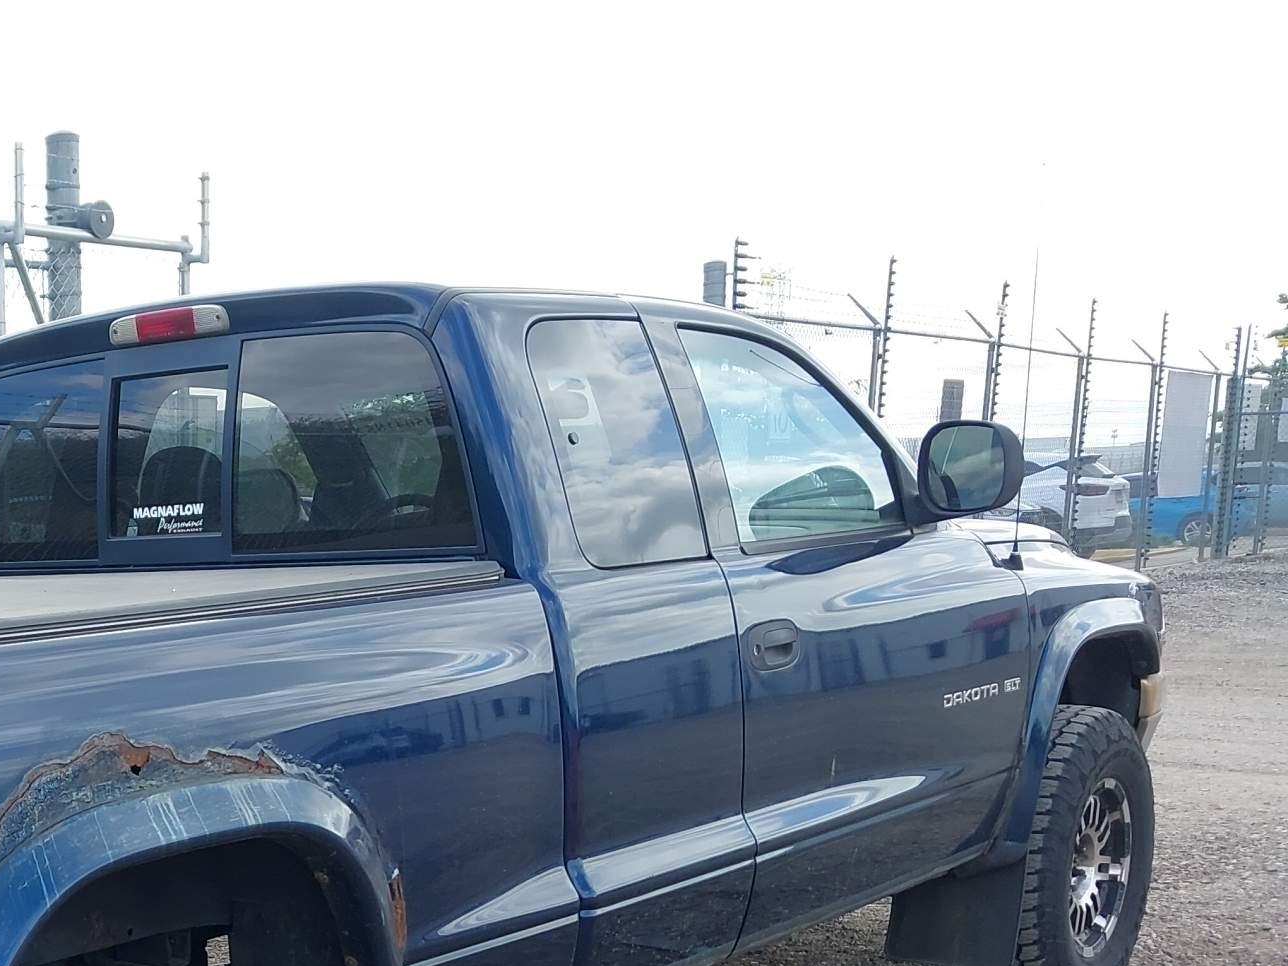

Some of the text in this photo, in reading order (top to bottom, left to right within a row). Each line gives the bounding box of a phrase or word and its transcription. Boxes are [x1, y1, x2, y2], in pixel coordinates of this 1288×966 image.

[133, 503, 204, 519] MAGNAFLOW
[157, 517, 204, 533] Performance
[943, 683, 999, 708] DAKOTA
